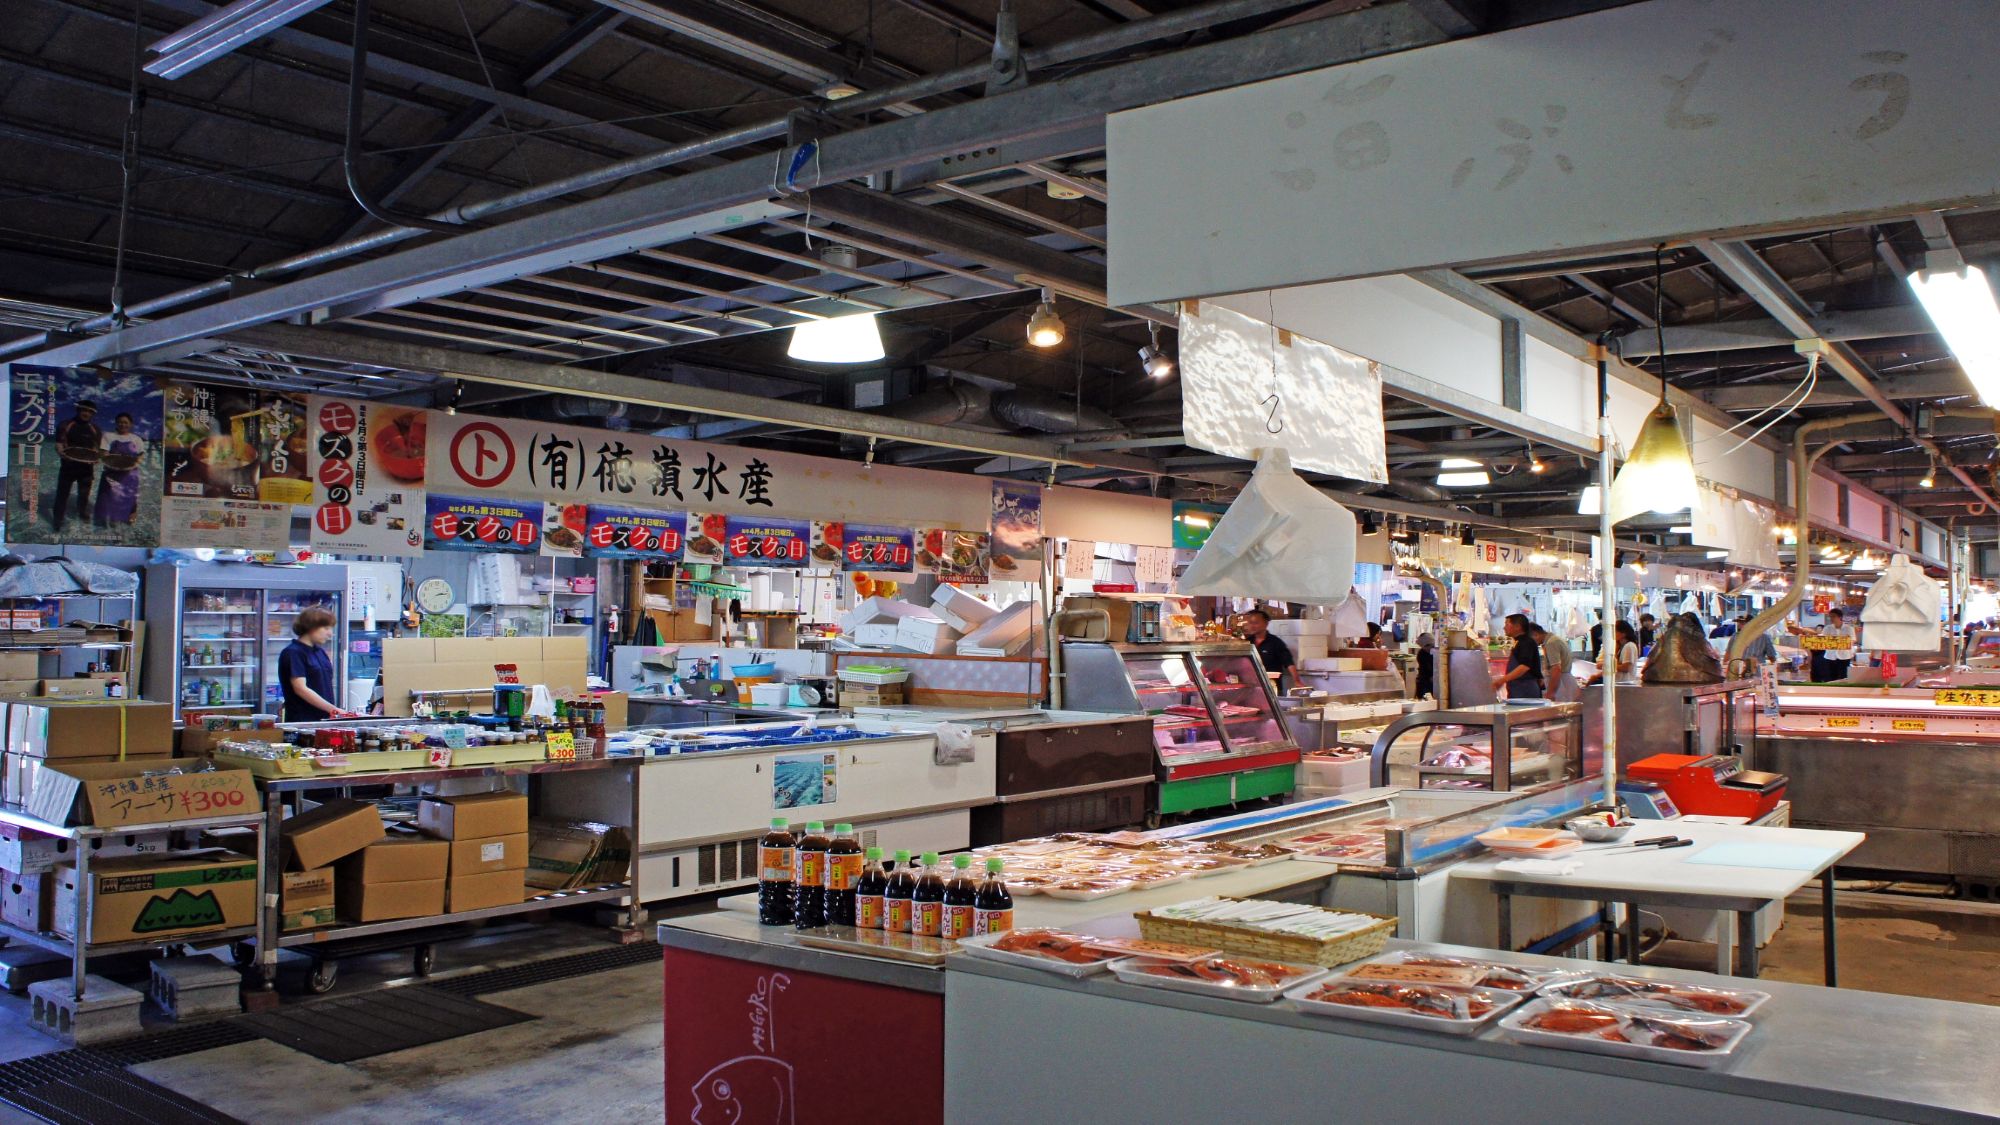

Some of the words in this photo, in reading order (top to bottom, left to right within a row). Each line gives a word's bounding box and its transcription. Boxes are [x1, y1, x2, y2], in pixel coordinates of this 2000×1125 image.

[11, 372, 45, 465] モズクの日
[171, 388, 191, 448] もずく
[193, 388, 210, 429] 沖縄
[321, 405, 352, 531] モズクの日
[434, 514, 534, 543] モズクの日
[592, 525, 678, 550] モズクの日
[730, 536, 803, 557] モズクの日
[848, 542, 908, 563] モズクの日
[99, 777, 173, 799] 沖縄県産
[110, 793, 176, 820] アーサ
[181, 789, 245, 815] ¥300
[203, 868, 243, 882] レタス
